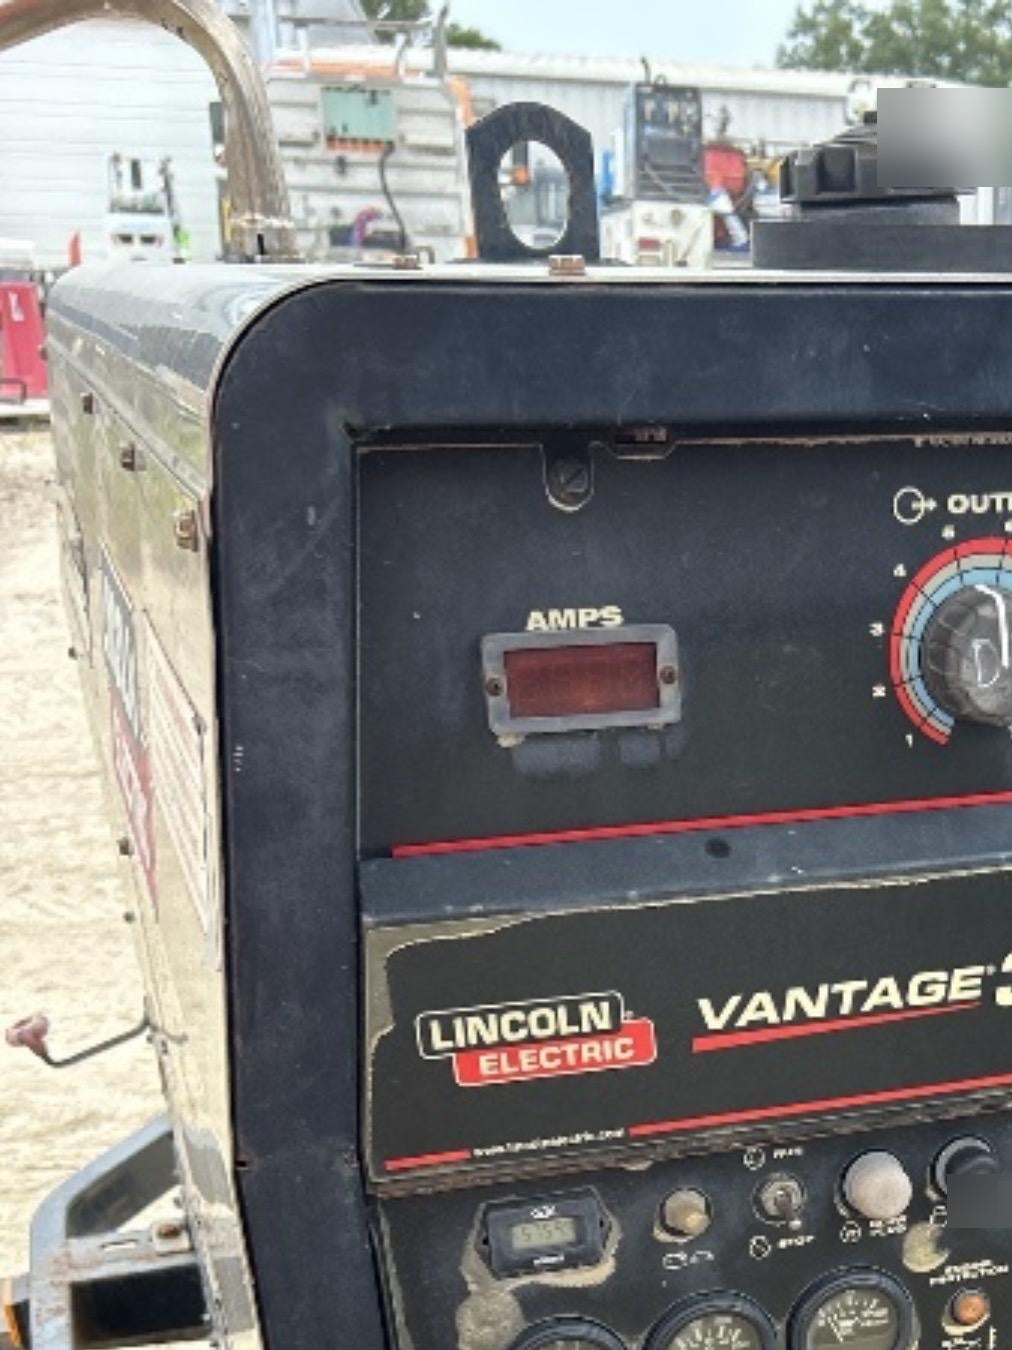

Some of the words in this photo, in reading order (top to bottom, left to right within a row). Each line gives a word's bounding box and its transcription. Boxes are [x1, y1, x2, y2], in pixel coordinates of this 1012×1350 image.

[893, 563, 906, 578] 4
[526, 605, 623, 632] AMPS
[698, 966, 987, 1031] VANTAGE
[430, 1001, 612, 1051] LINCOLN
[479, 1036, 635, 1077] ELECTRIC
